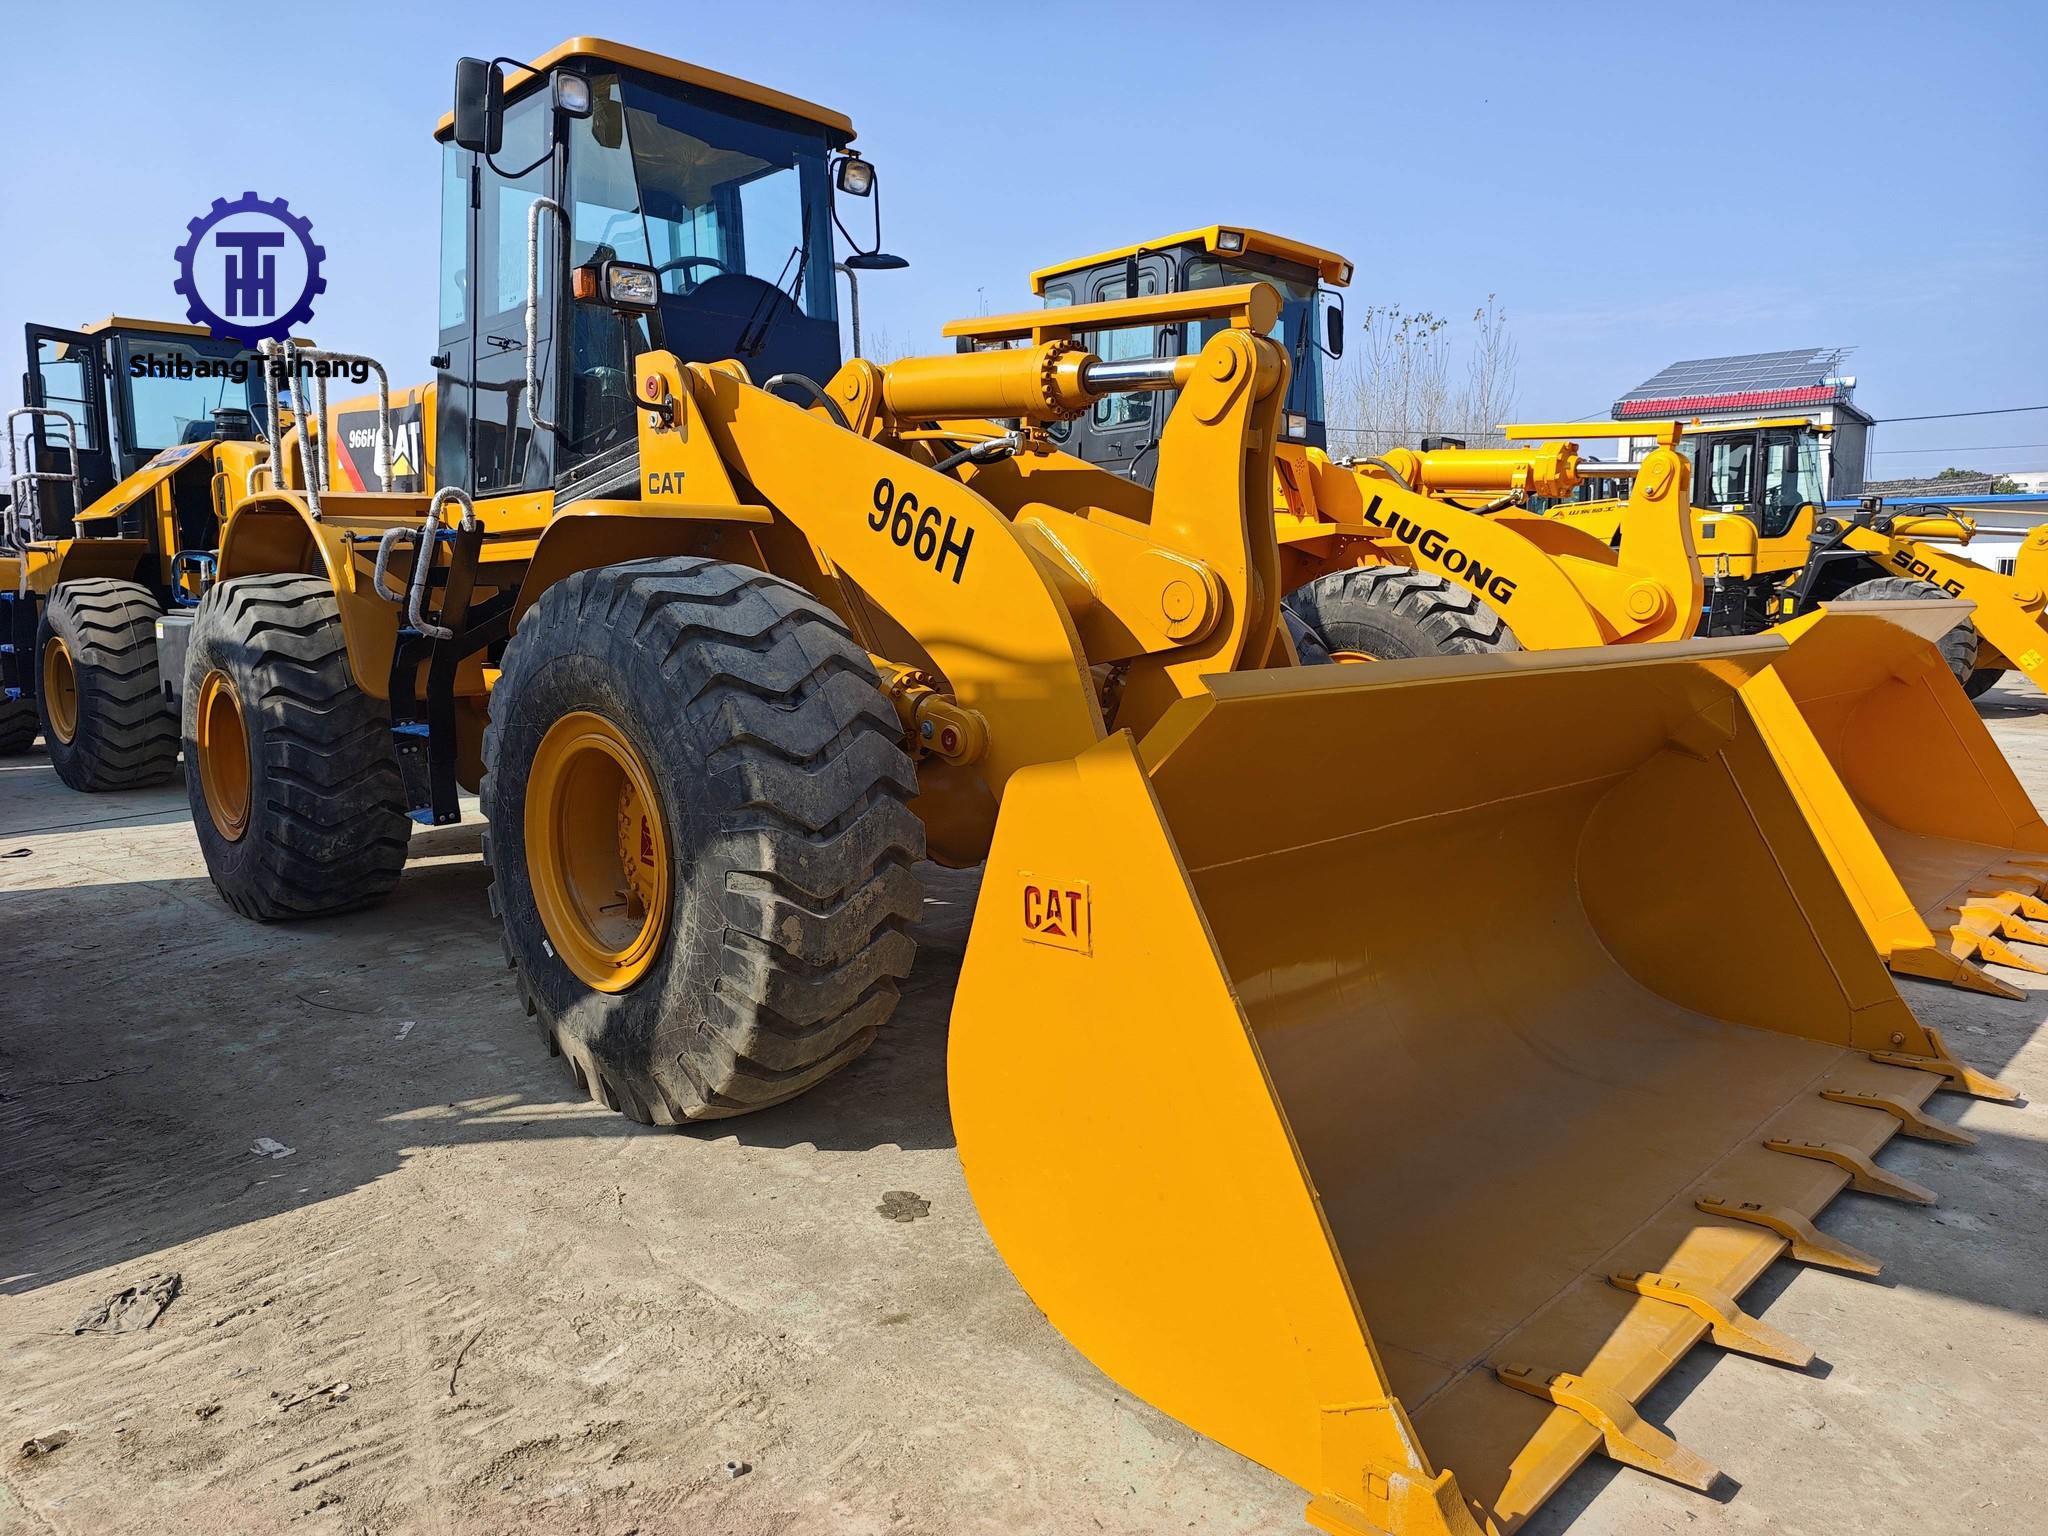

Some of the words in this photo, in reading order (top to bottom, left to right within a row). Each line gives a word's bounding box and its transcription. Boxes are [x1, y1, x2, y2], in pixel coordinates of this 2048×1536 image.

[348, 428, 376, 449] 966H
[648, 471, 686, 495] CAT
[868, 478, 975, 585] 966H
[1891, 550, 1965, 598] SDLG
[1024, 885, 1082, 938] CAT
